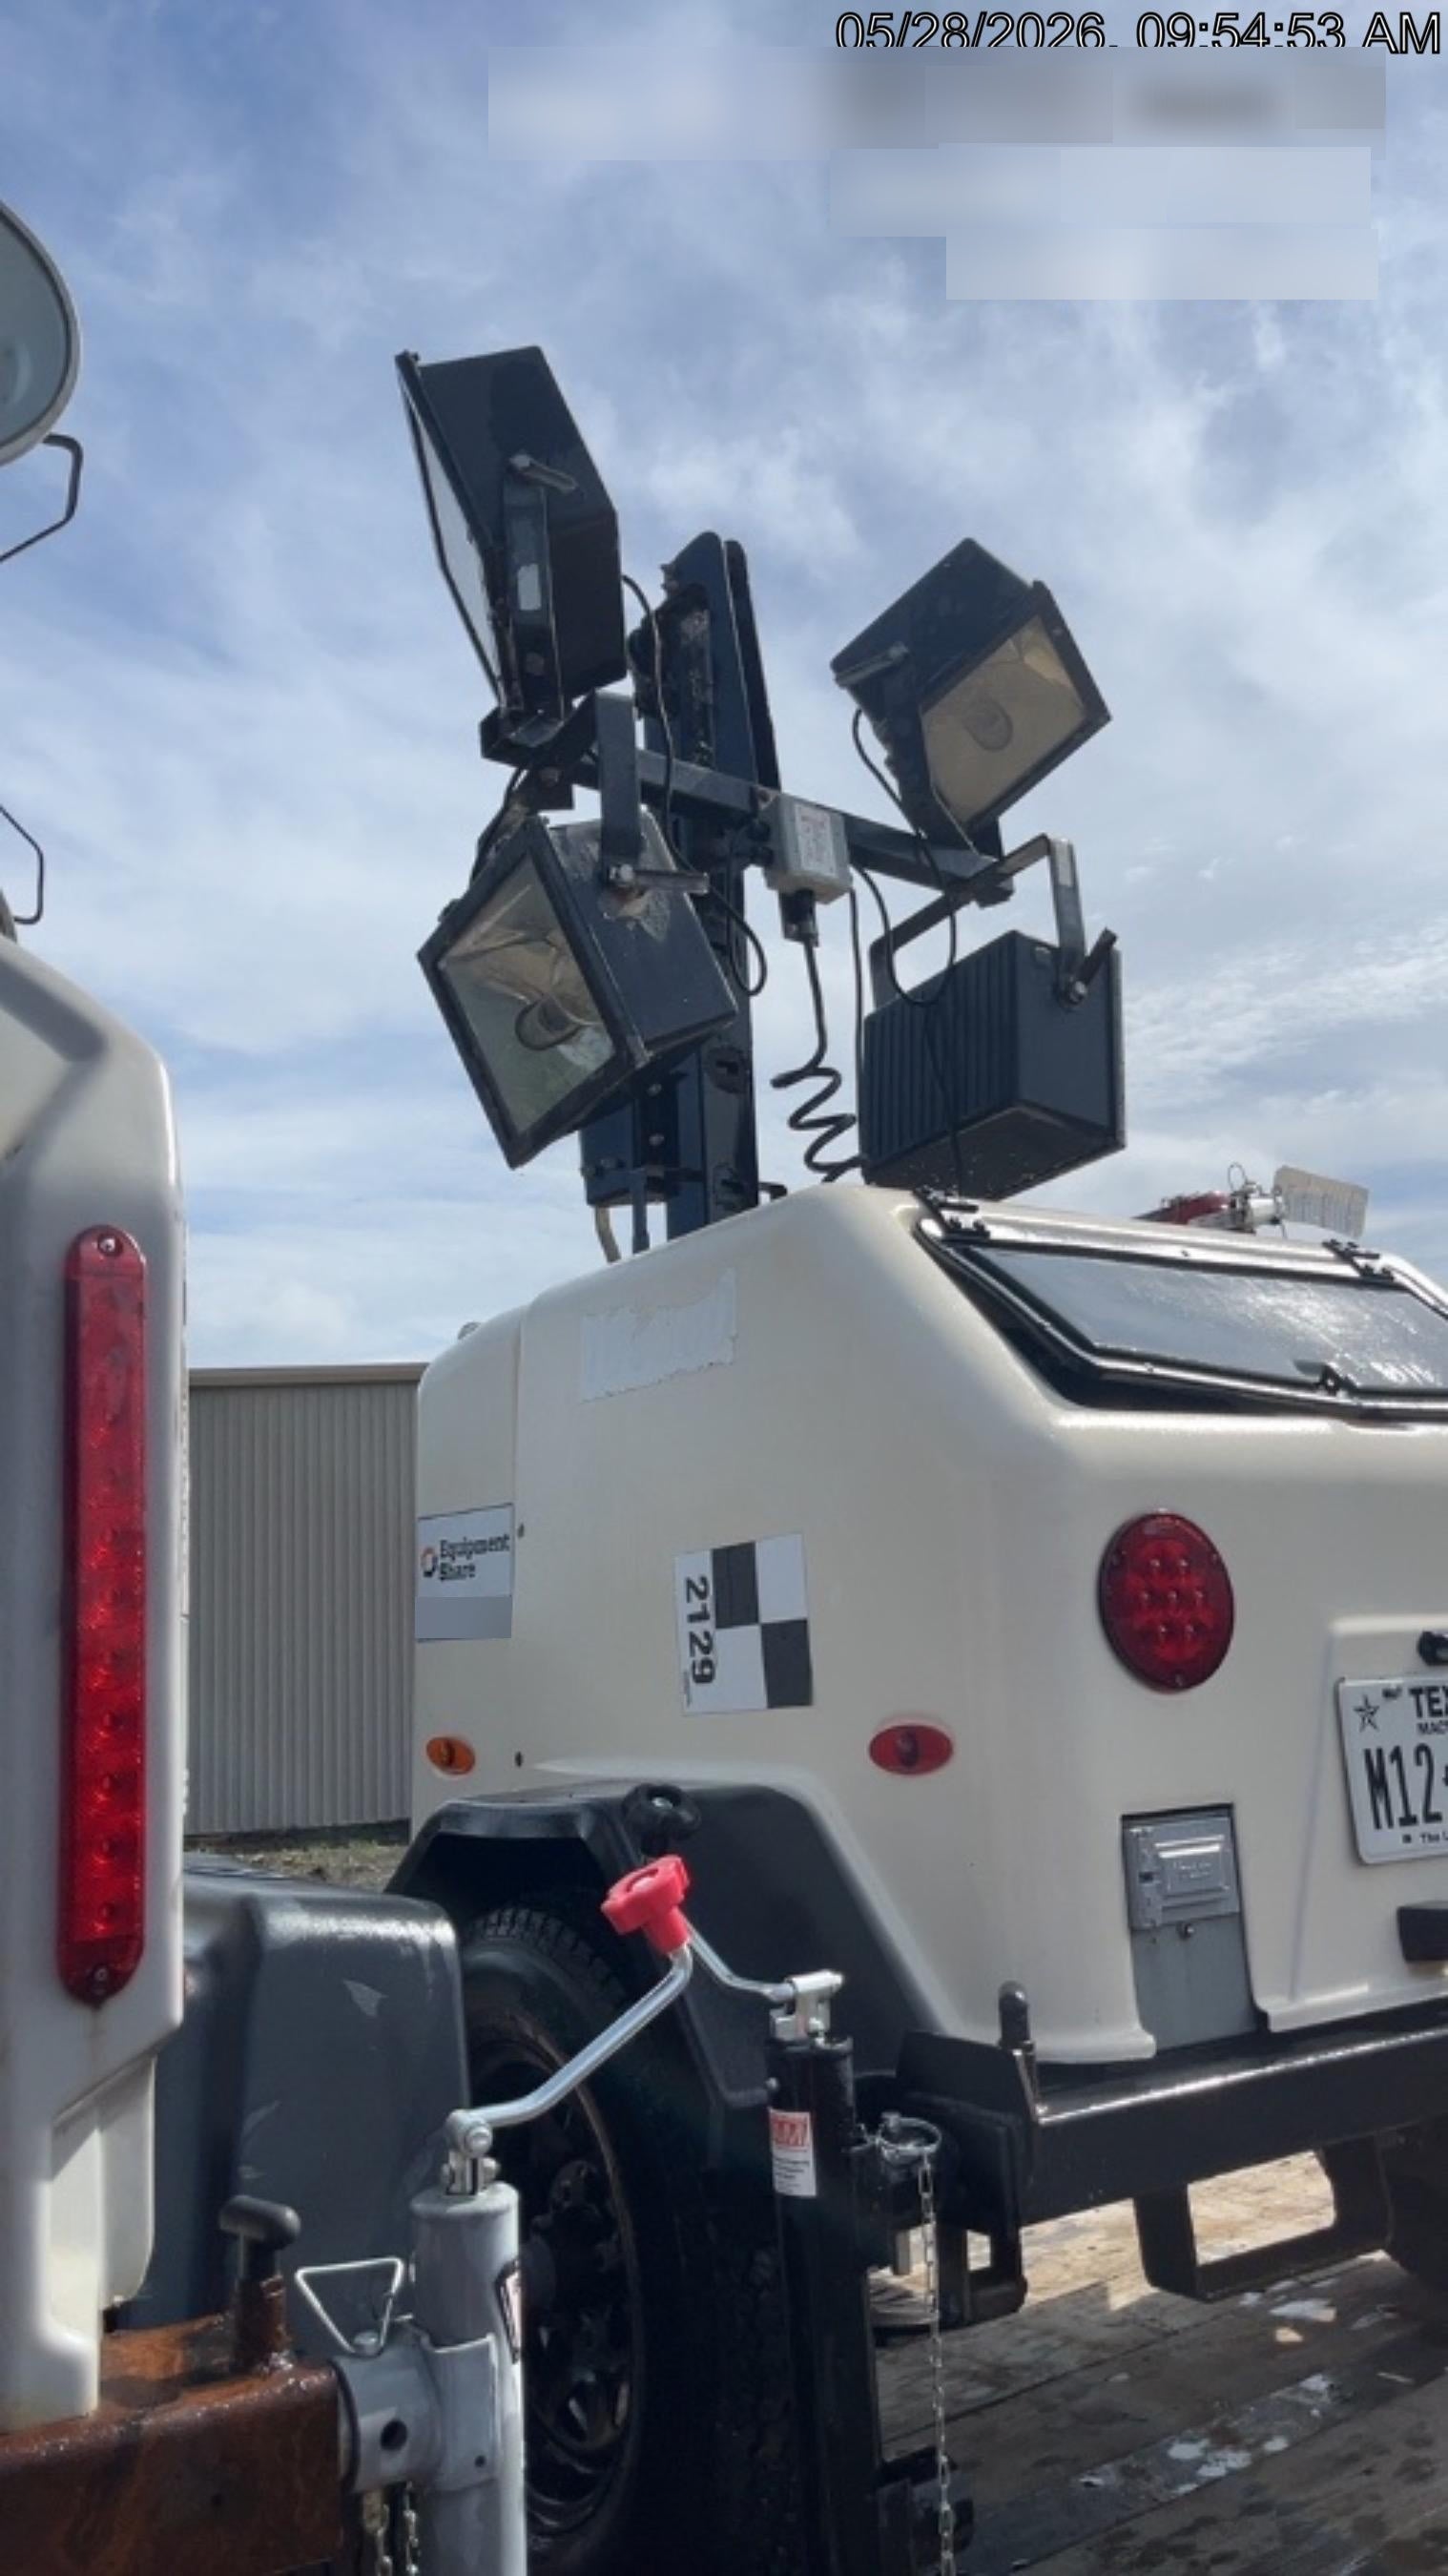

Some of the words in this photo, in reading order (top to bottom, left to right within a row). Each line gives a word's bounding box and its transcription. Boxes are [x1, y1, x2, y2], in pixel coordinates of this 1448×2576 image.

[440, 1533, 510, 1561] Equipment
[439, 1562, 476, 1581] Share
[686, 1576, 715, 1685] 2129
